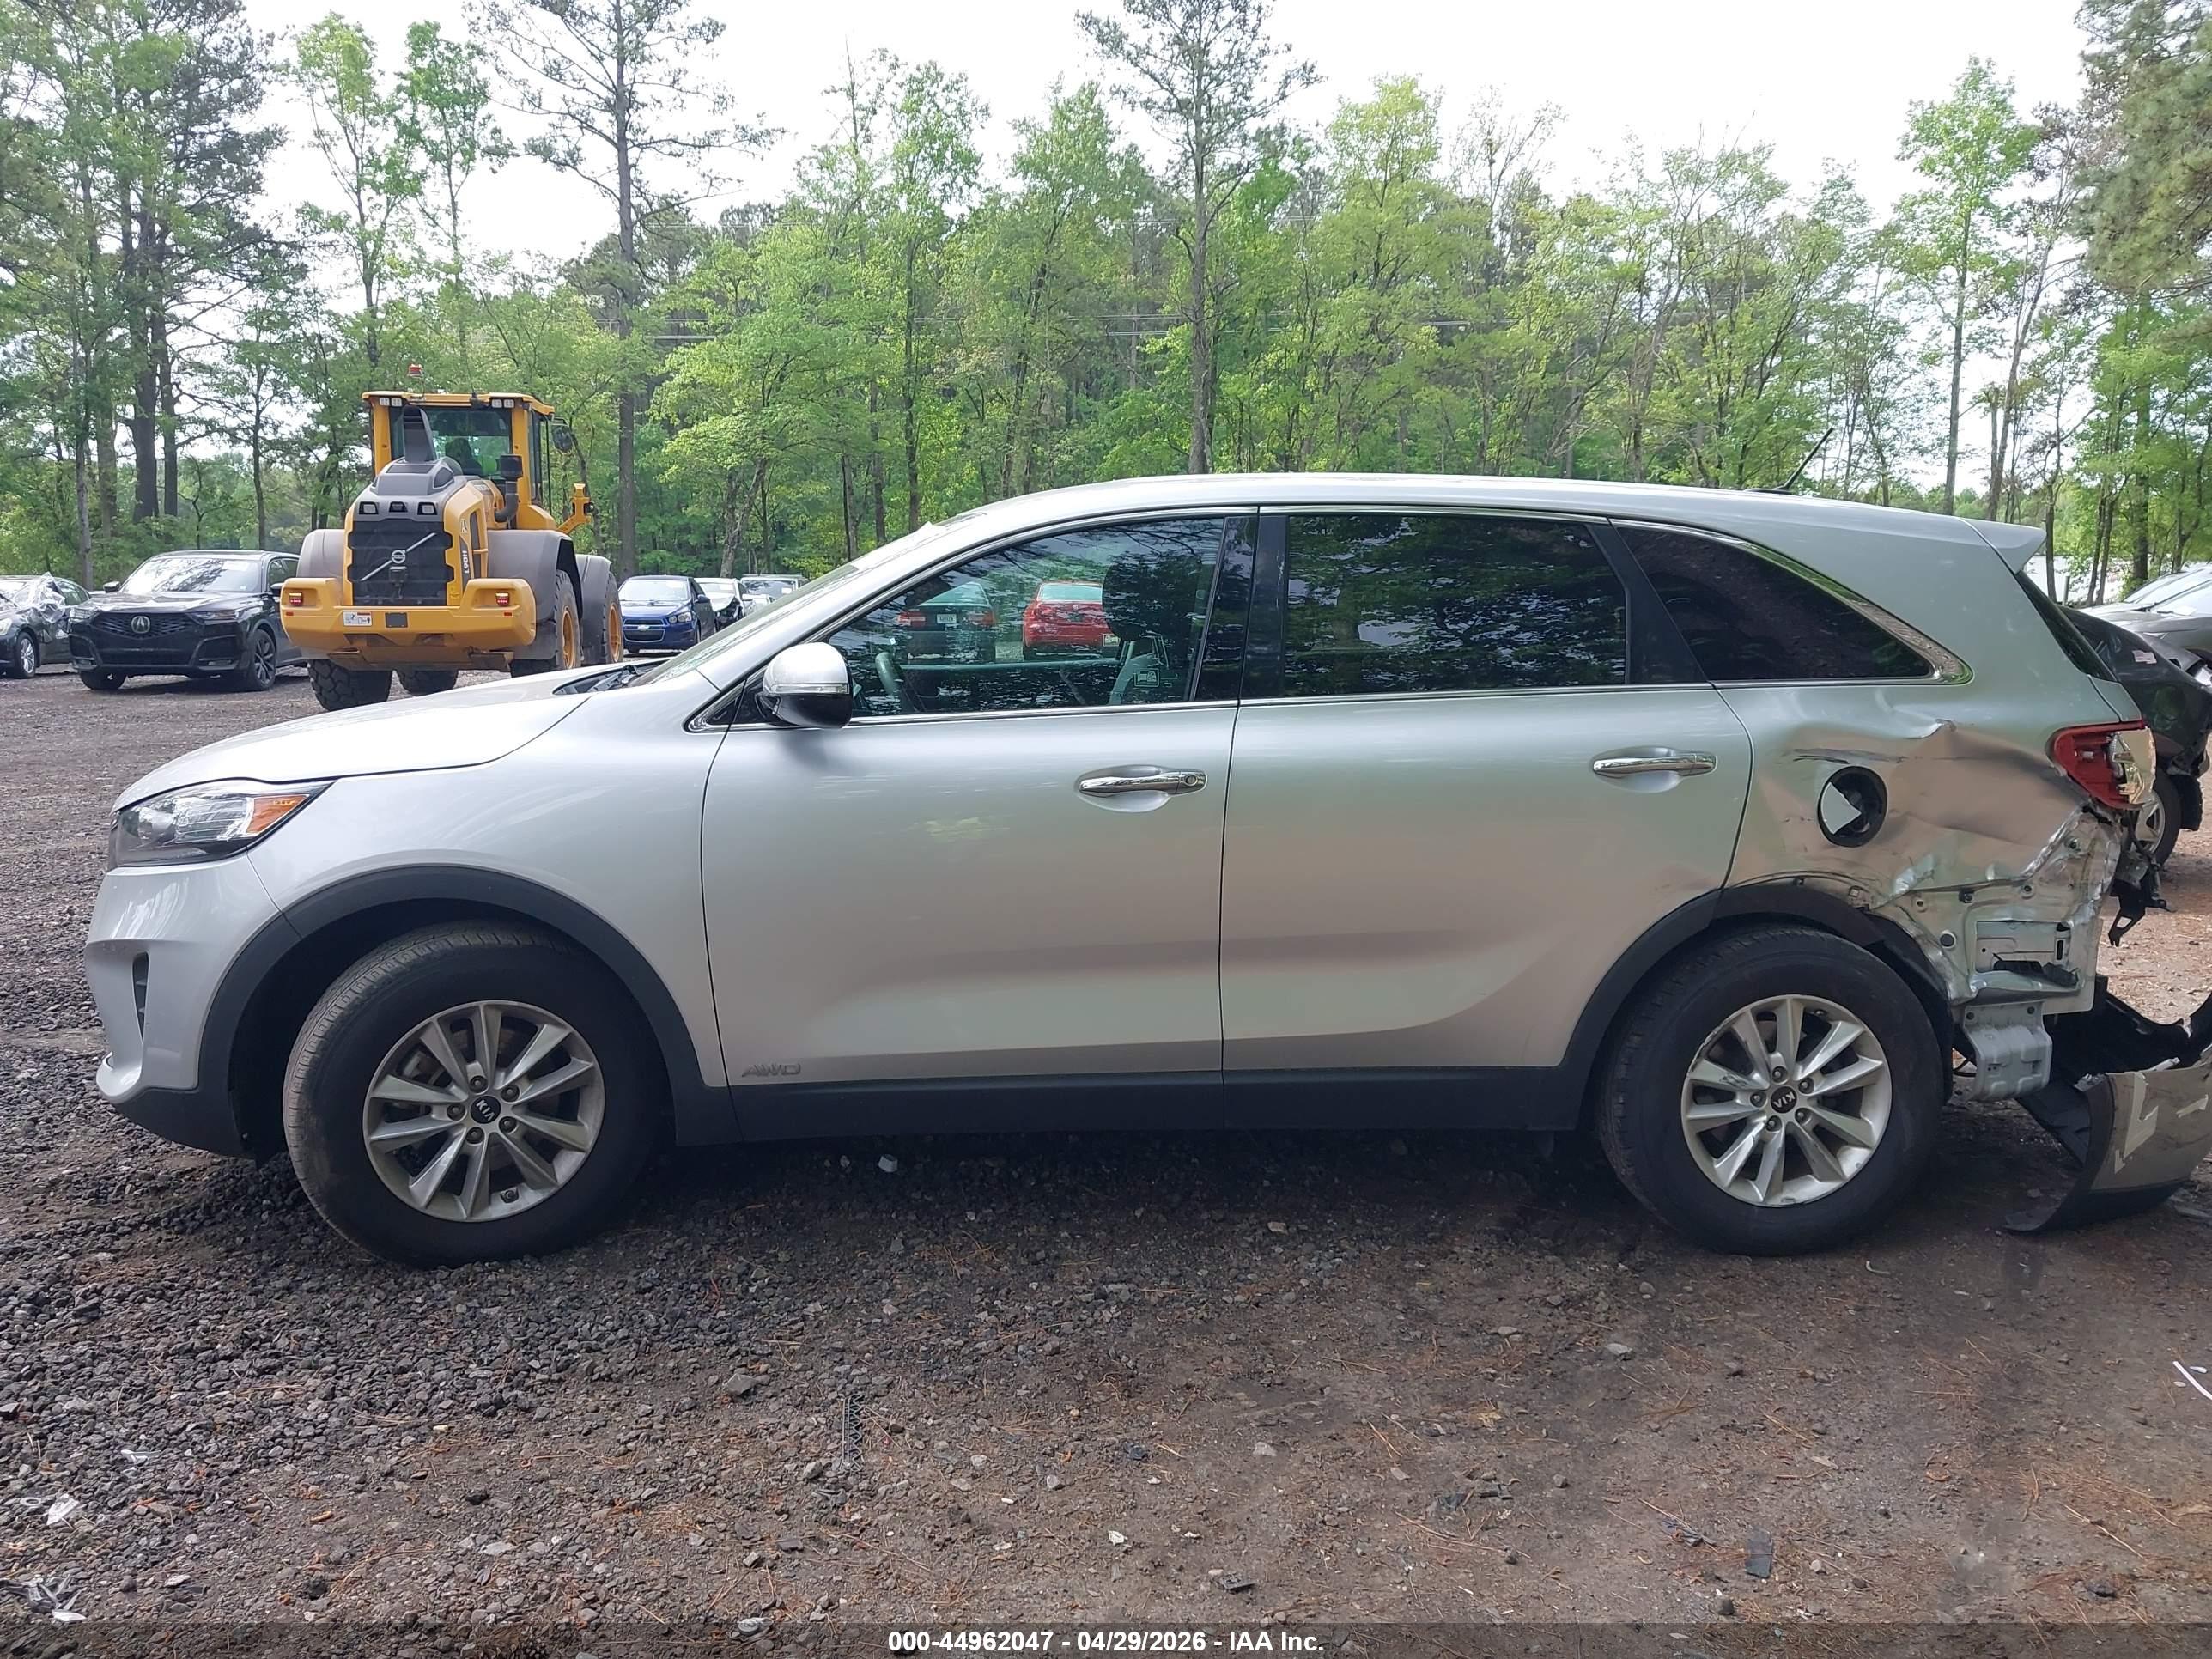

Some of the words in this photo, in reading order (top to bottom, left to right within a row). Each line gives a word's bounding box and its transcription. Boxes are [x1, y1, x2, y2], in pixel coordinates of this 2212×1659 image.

[741, 1063, 801, 1078] AWD
[1773, 1091, 1796, 1108] KIA
[476, 1099, 495, 1121] KIA
